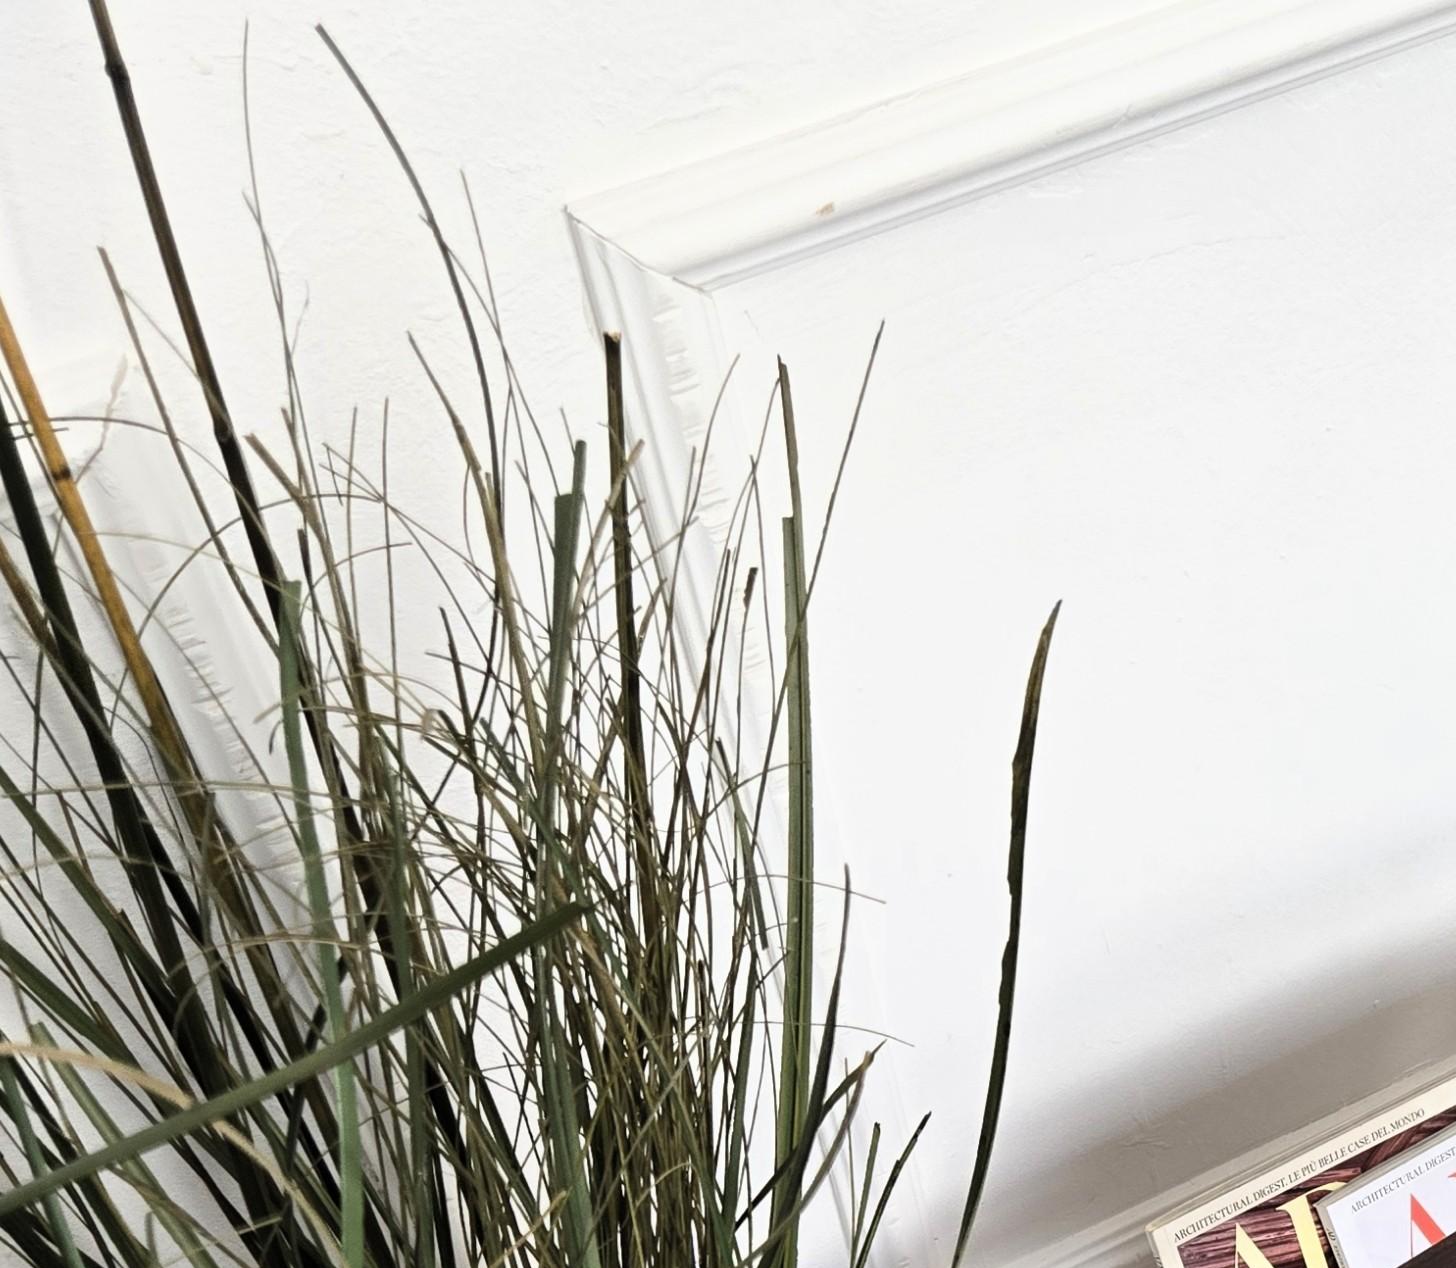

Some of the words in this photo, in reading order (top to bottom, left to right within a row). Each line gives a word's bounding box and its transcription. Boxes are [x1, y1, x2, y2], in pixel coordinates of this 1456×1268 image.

[1173, 1196, 1252, 1243] ARCHITECTURAL
[1288, 1170, 1301, 1186] LE
[1300, 1159, 1318, 1179] PIÙ
[1318, 1148, 1347, 1171] BELLE
[1347, 1136, 1371, 1158] CASE
[1371, 1126, 1391, 1146] DEL
[1389, 1108, 1426, 1136] MONDO
[1350, 1167, 1424, 1214] ARCHITECTURAL
